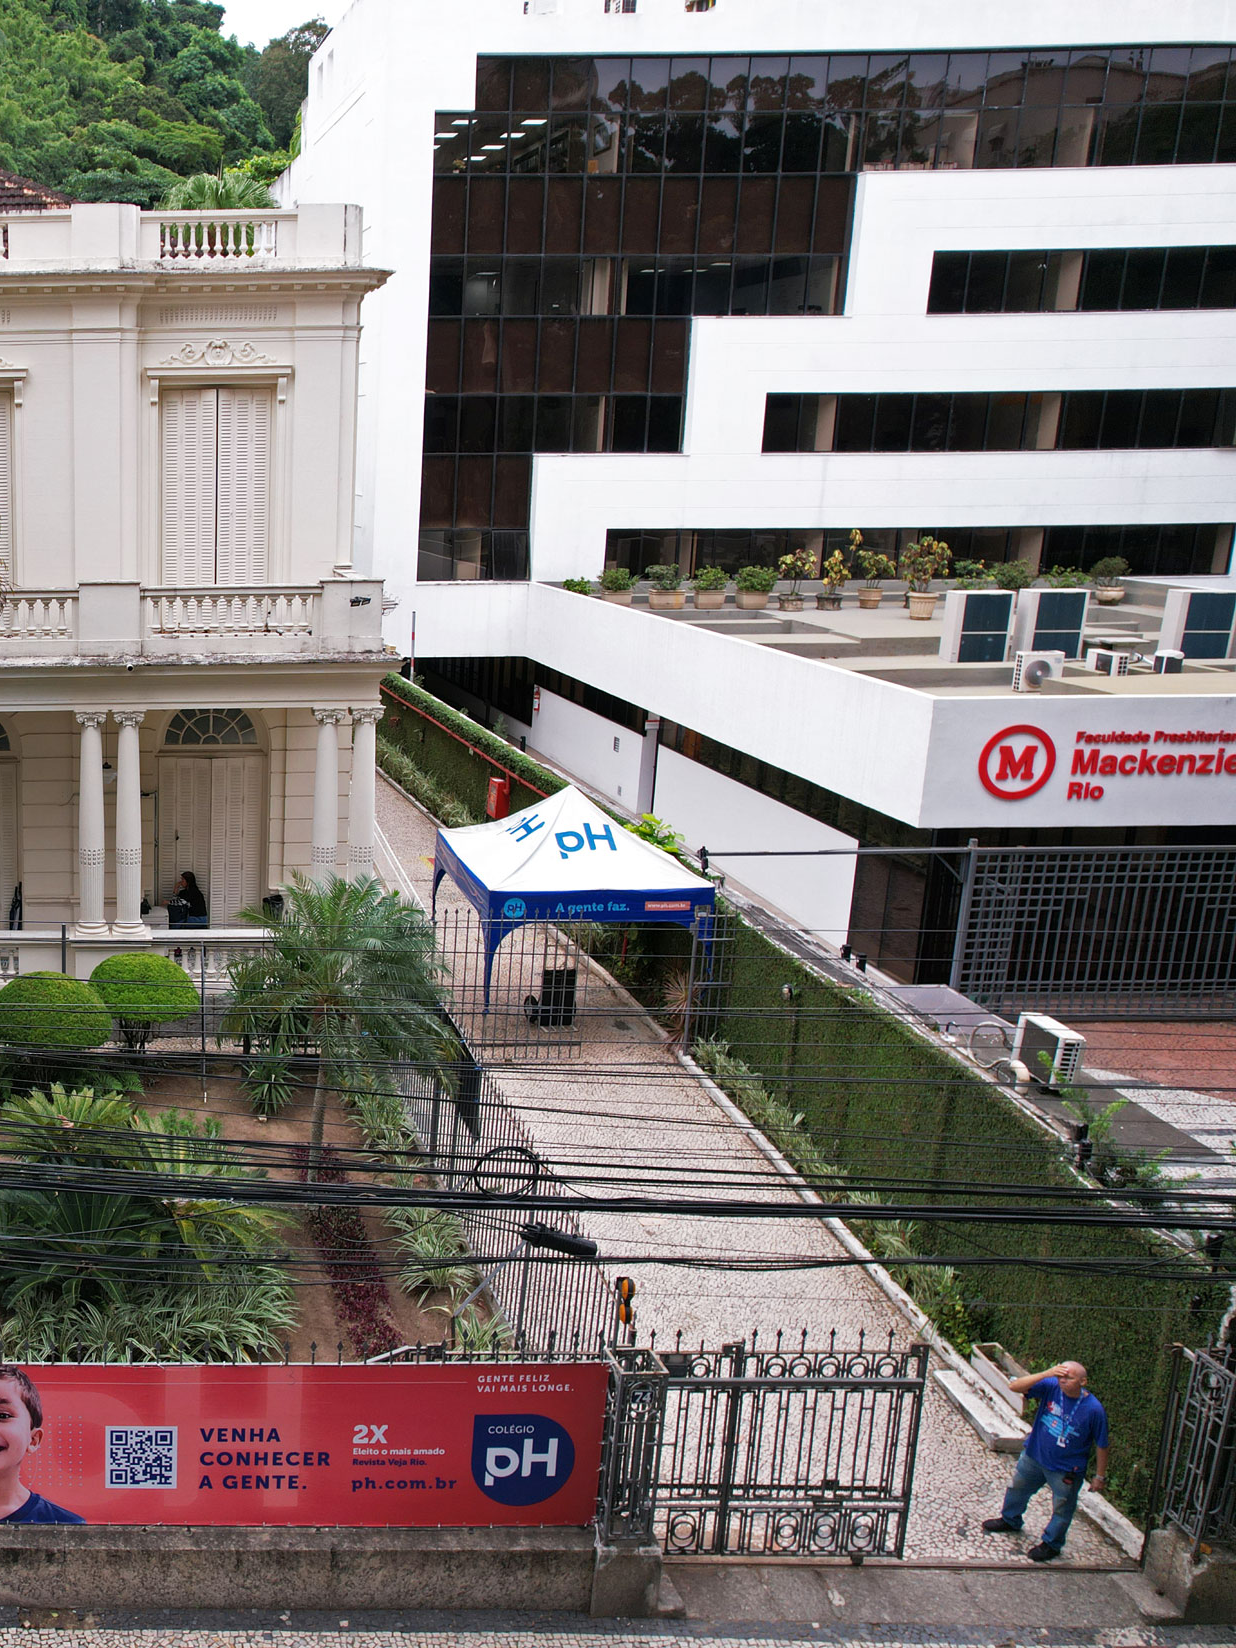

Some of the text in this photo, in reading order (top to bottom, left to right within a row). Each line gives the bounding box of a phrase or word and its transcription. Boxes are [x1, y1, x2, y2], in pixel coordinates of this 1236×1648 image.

[1076, 731, 1150, 744] Faculdade
[996, 746, 1038, 780] M
[1067, 782, 1104, 800] Rio
[555, 823, 617, 859] pH
[556, 901, 630, 915] A gente faz.
[519, 1374, 550, 1382] FELIZ
[500, 1384, 528, 1392] MAIS
[532, 1384, 574, 1392] LONGE.
[634, 1392, 652, 1403] 74
[200, 1428, 280, 1442] VENHA
[352, 1424, 388, 1444] 2X
[488, 1424, 534, 1434] COLÉGIO
[200, 1452, 330, 1466] CONHECER
[352, 1448, 379, 1456] Eleito
[390, 1448, 410, 1456] mais
[412, 1448, 445, 1456] amado
[352, 1458, 427, 1468] Revista Veja Rio.
[484, 1438, 559, 1486] pH
[198, 1475, 307, 1490] A GENTE.
[352, 1477, 457, 1492] ph.com.br
